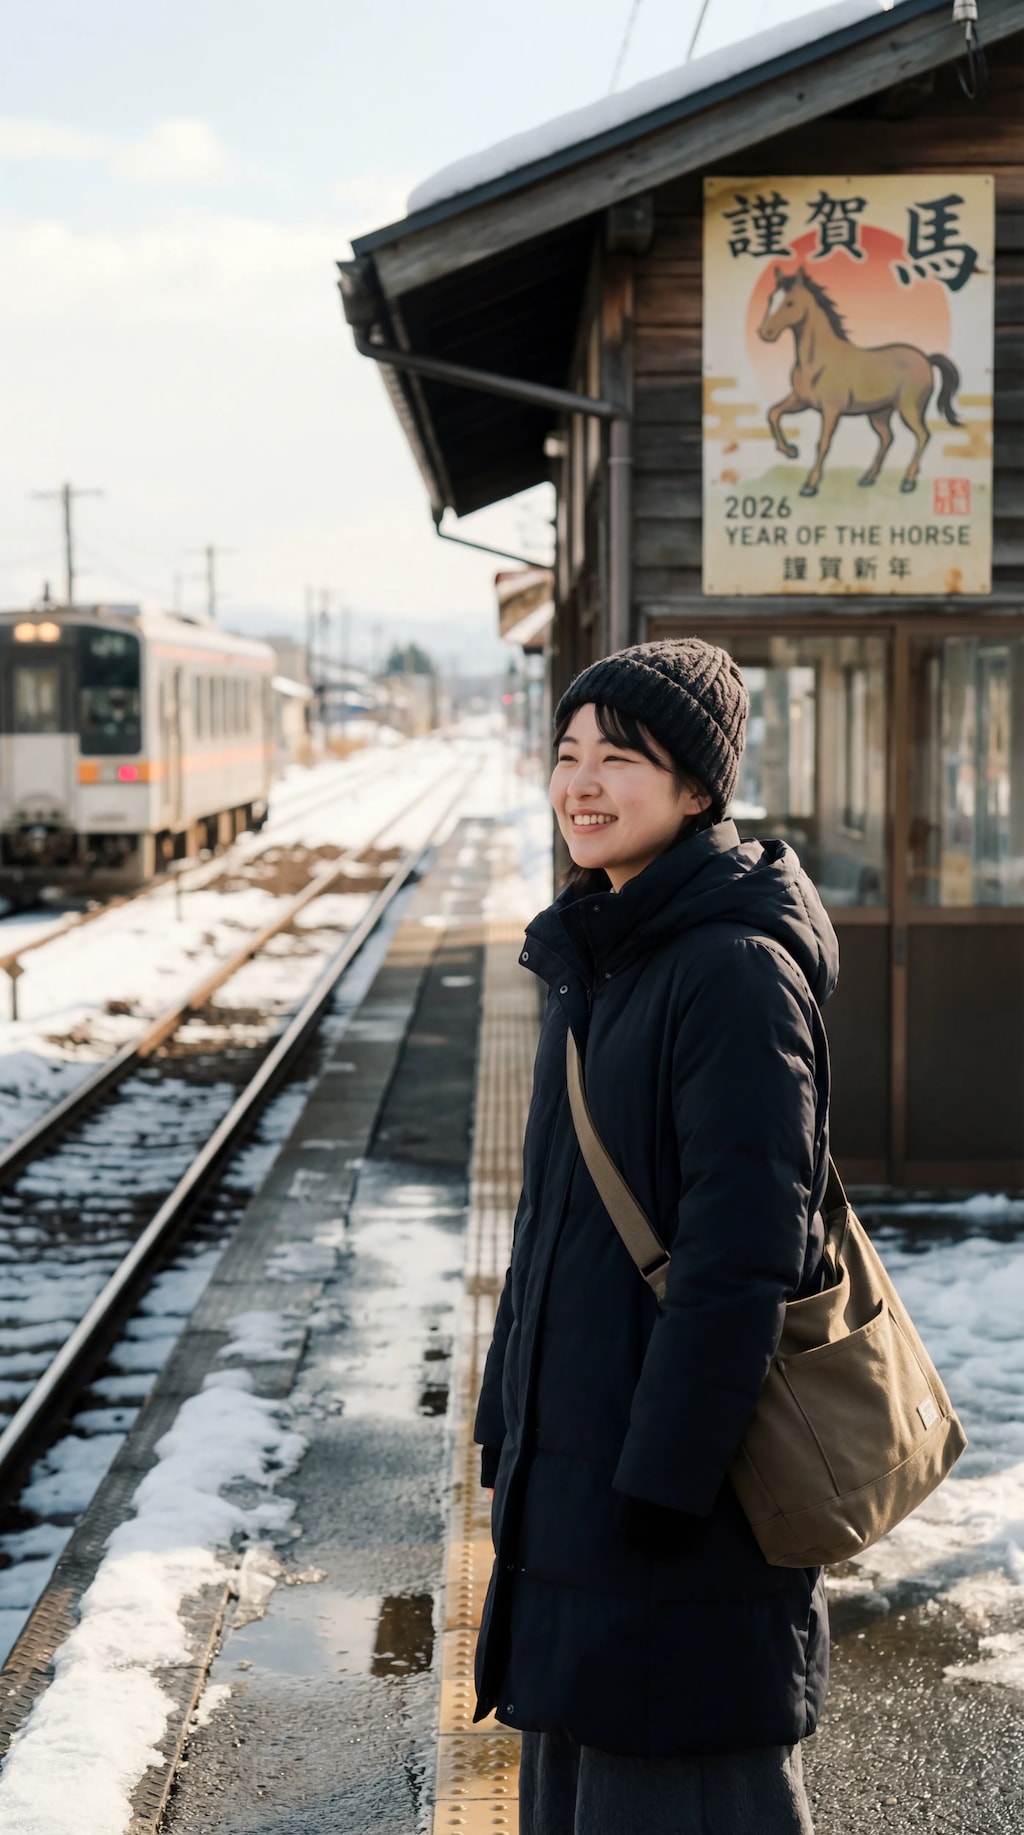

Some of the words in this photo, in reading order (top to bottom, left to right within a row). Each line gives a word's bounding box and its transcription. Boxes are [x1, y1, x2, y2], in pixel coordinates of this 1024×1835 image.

[725, 496, 791, 519] 2026
[725, 525, 788, 546] YEAR
[796, 525, 827, 546] OF
[836, 525, 881, 546] THE
[890, 525, 971, 546] HORSE
